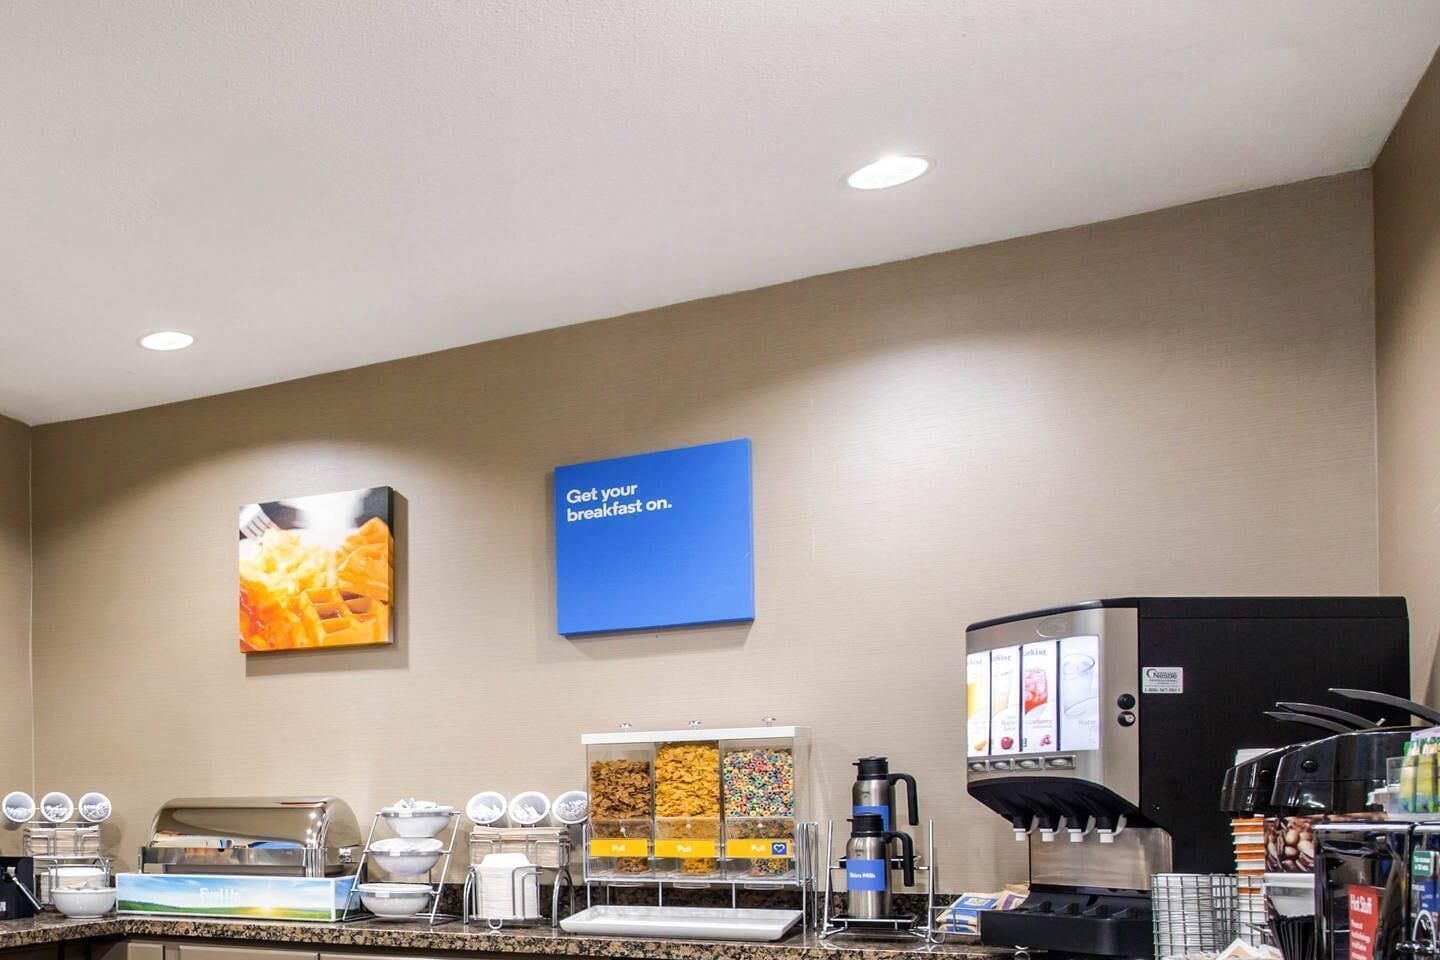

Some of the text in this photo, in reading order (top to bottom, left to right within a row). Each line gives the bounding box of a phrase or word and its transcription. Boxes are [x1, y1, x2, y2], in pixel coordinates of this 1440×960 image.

[566, 484, 638, 504] Get your
[567, 498, 672, 522] breakfast on.
[611, 844, 626, 852] Pull
[676, 845, 692, 853] Pull
[750, 844, 766, 852] Pull
[199, 887, 224, 900] Fuel
